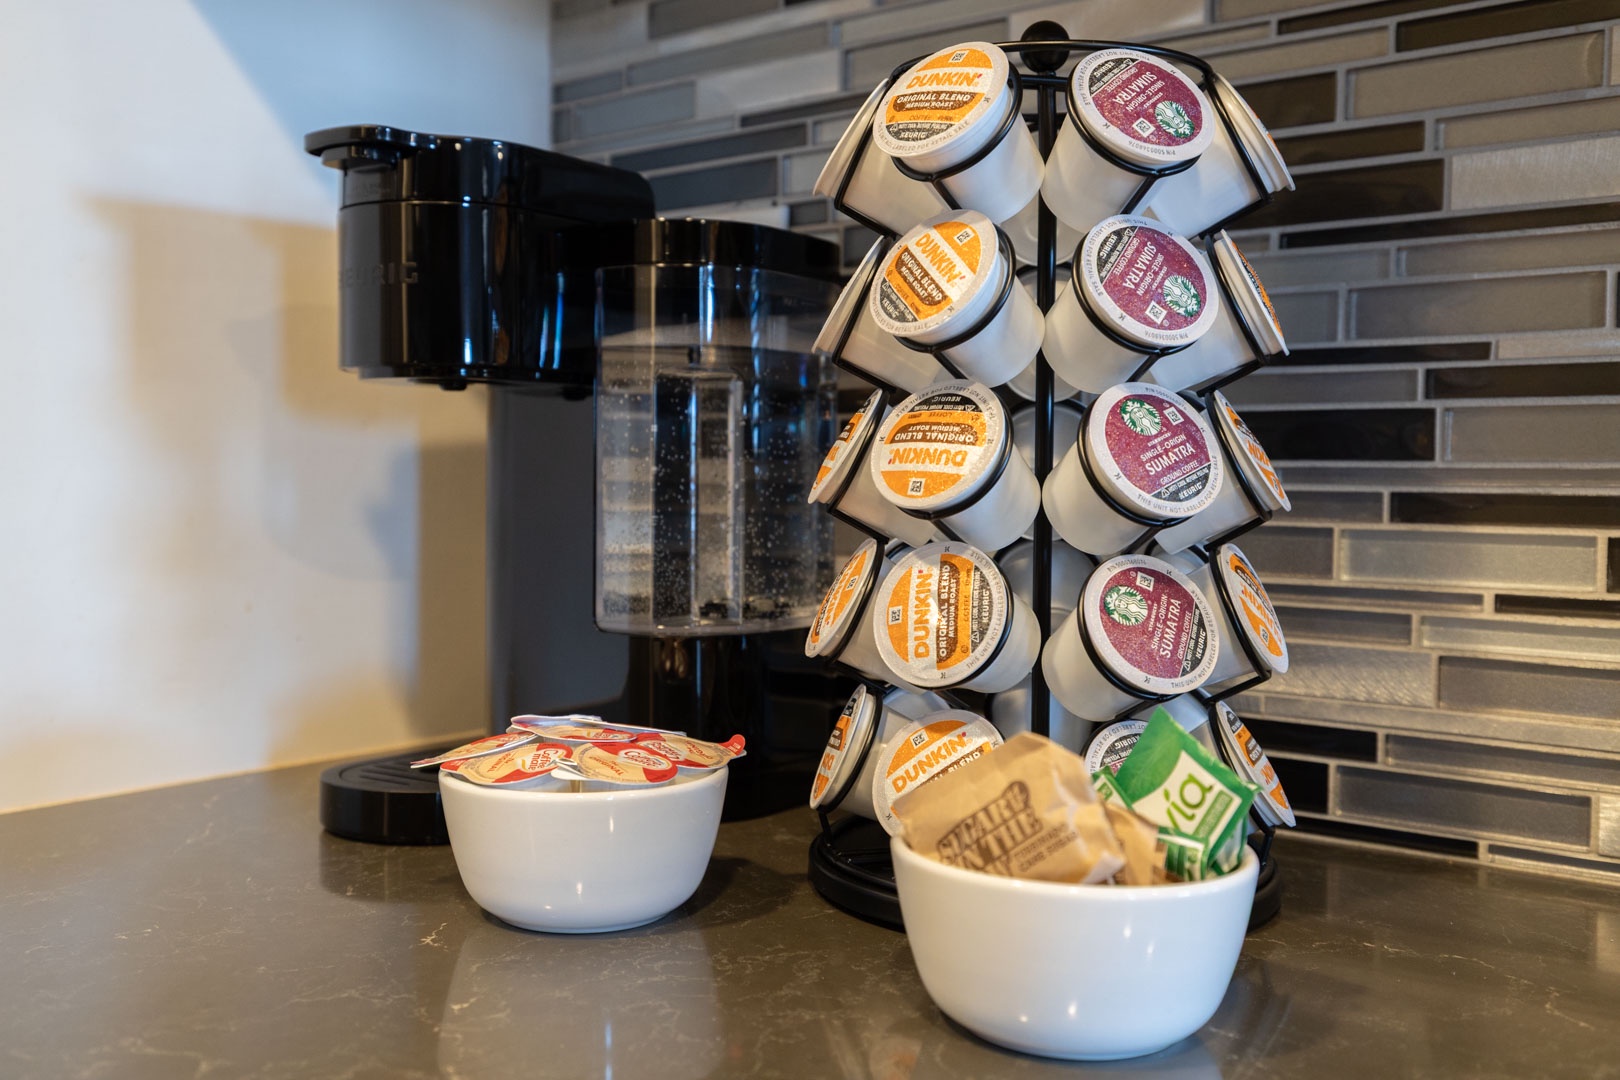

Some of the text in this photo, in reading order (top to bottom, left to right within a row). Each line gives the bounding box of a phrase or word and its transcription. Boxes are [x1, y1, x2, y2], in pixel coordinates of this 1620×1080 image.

[906, 72, 982, 89] DUNKIN'
[1112, 72, 1157, 105] SUMATRA
[897, 92, 971, 103] ORIGINAL BLEND
[915, 233, 966, 284] DUNKIN'
[1099, 234, 1118, 259] KEURIG
[1113, 256, 1128, 275] COFFEE
[1122, 242, 1157, 289] SUMATRA
[1136, 253, 1165, 296] SINGLE-ORIGIN
[920, 276, 943, 301] BLEND
[895, 432, 974, 442] ORIGINAL BLEND
[1140, 434, 1187, 462] SINGLE-ORIGIN
[888, 448, 969, 467] DUNKIN'
[1145, 442, 1196, 475] SUMATRA
[1161, 470, 1182, 484] GROUND
[1182, 460, 1199, 473] COFFEE
[1178, 482, 1202, 499] KEURIG
[940, 565, 951, 599] BLEND
[914, 569, 933, 659] DUNKIN'
[948, 605, 956, 638] MEDIUM
[981, 589, 990, 623] KEURIG
[1151, 594, 1168, 650] SINGLE-ORIGIN
[1160, 599, 1181, 658] SUMATRA
[1177, 611, 1192, 659] GROUND COFFEE
[1195, 628, 1206, 659] KEURIG
[1115, 736, 1140, 749] KEURIG
[538, 749, 559, 769] Coffee
[892, 731, 967, 793] DUNKIN'
